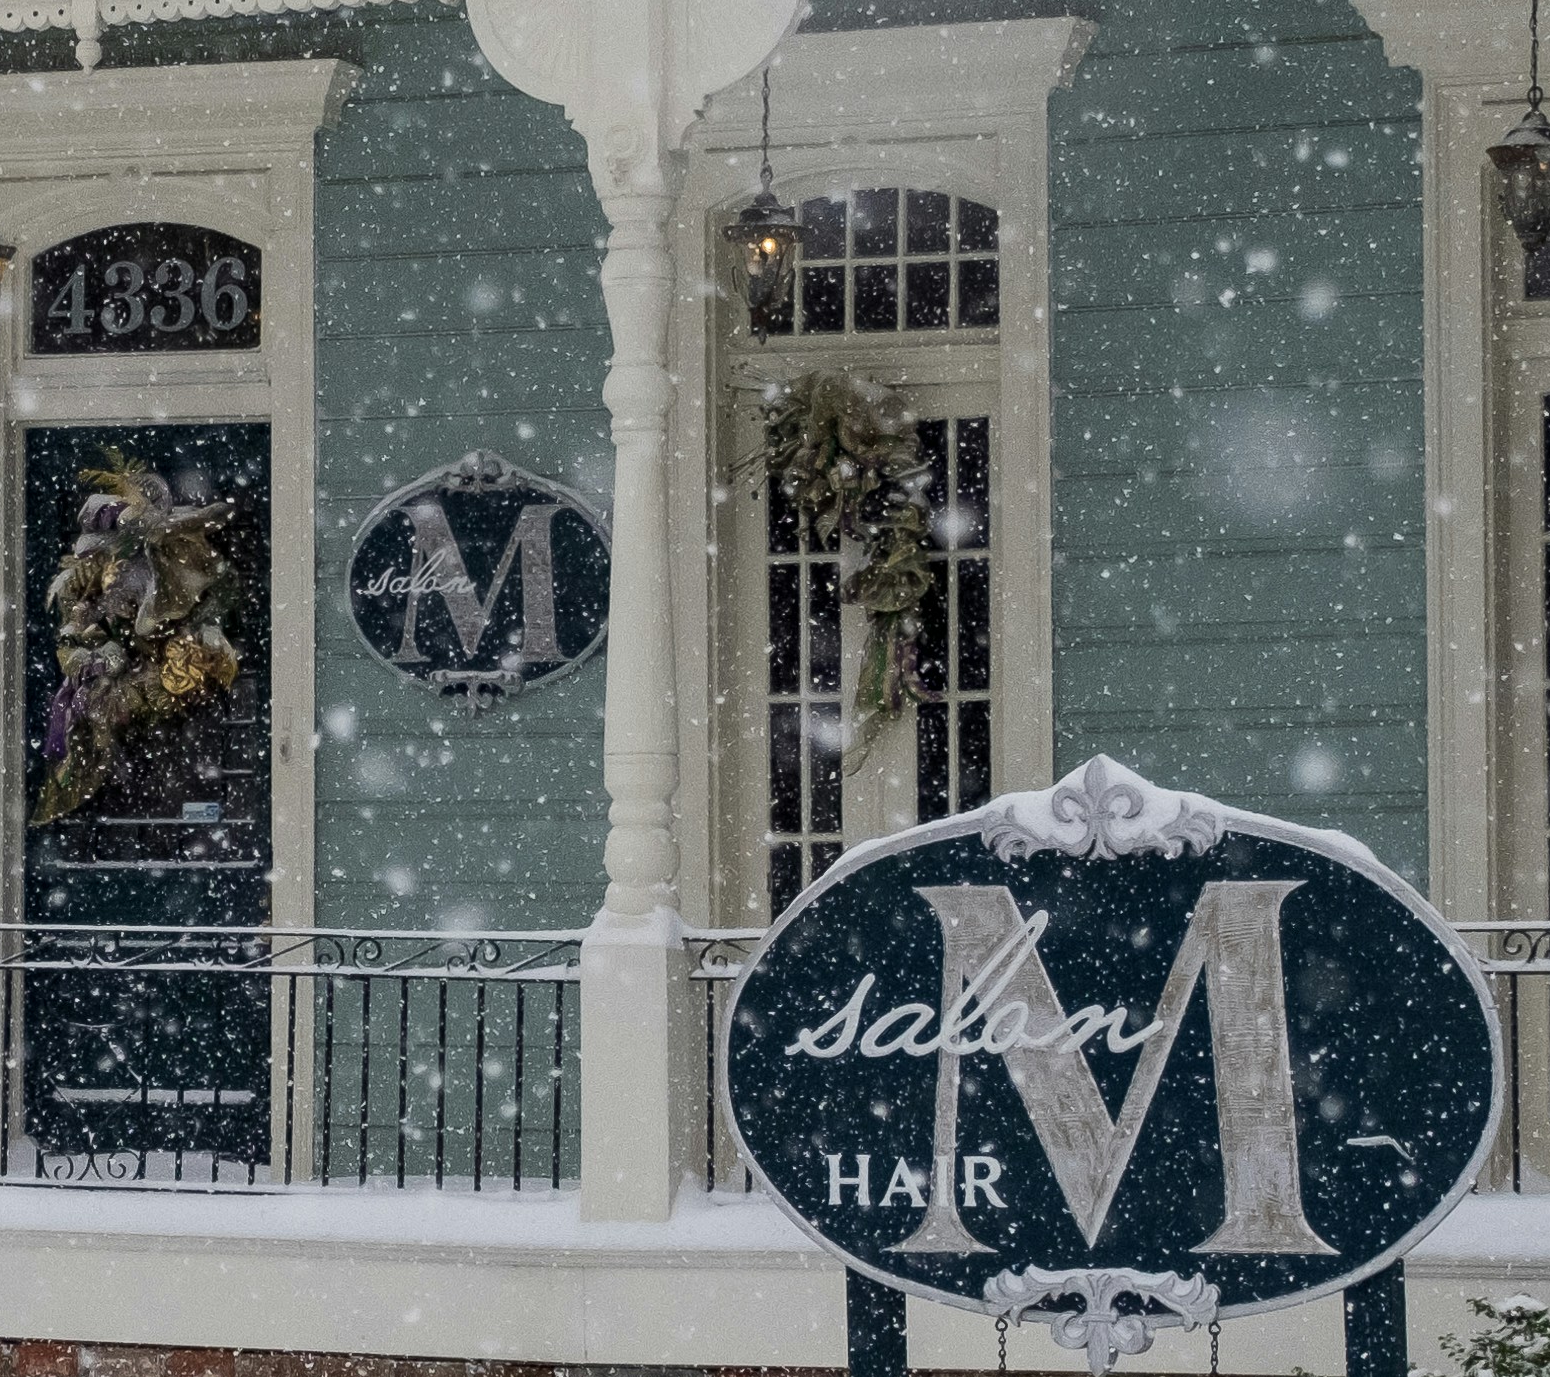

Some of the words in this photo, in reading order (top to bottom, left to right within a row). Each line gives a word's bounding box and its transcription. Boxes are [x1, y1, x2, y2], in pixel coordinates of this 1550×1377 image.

[48, 256, 248, 334] 4336
[359, 549, 477, 596] salon
[392, 504, 575, 663] M
[785, 909, 1166, 1058] salon
[883, 879, 1342, 1256] M
[826, 1154, 1008, 1210] HAIR
